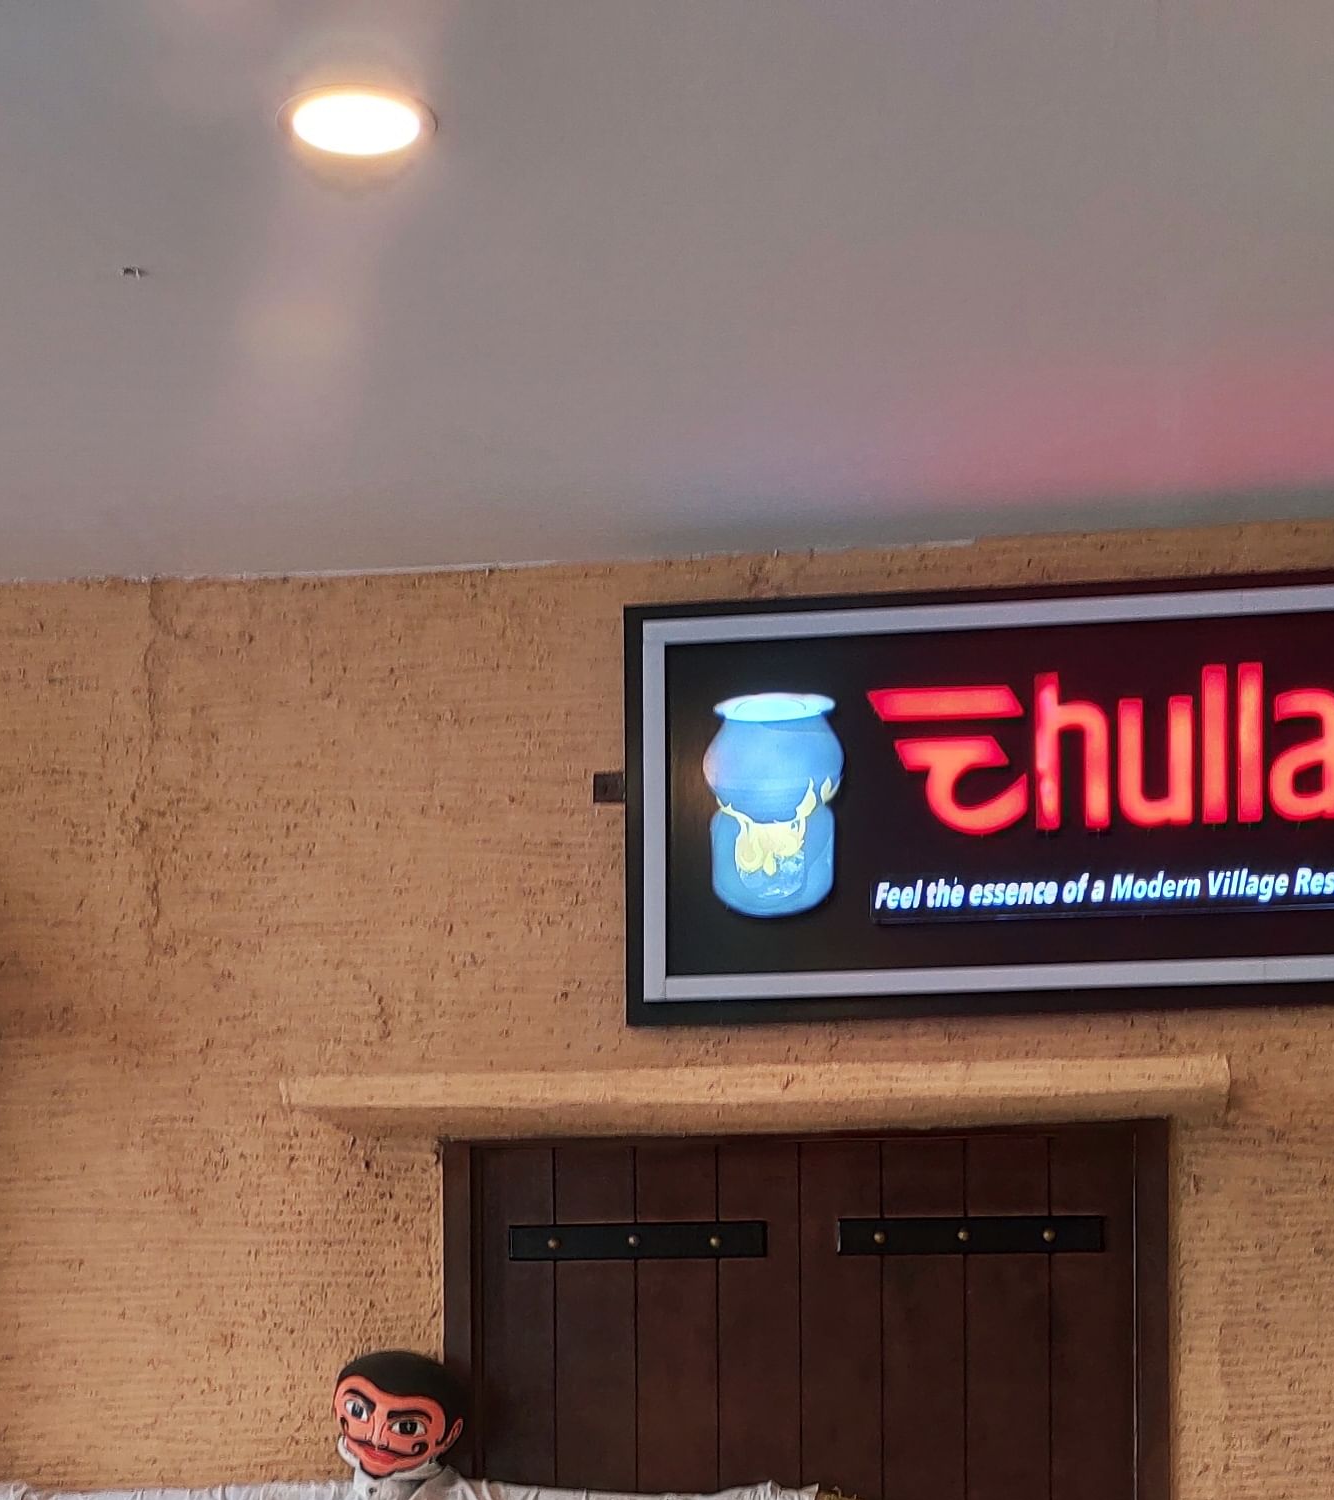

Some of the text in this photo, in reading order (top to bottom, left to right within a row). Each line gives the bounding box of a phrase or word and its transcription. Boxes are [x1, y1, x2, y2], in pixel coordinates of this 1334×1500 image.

[874, 878, 923, 909] Feel
[926, 876, 965, 909] the
[969, 880, 1058, 907] essence
[1062, 872, 1090, 904] of
[1090, 879, 1105, 903] a
[1110, 870, 1201, 902] Modern
[1208, 868, 1289, 903] Village
